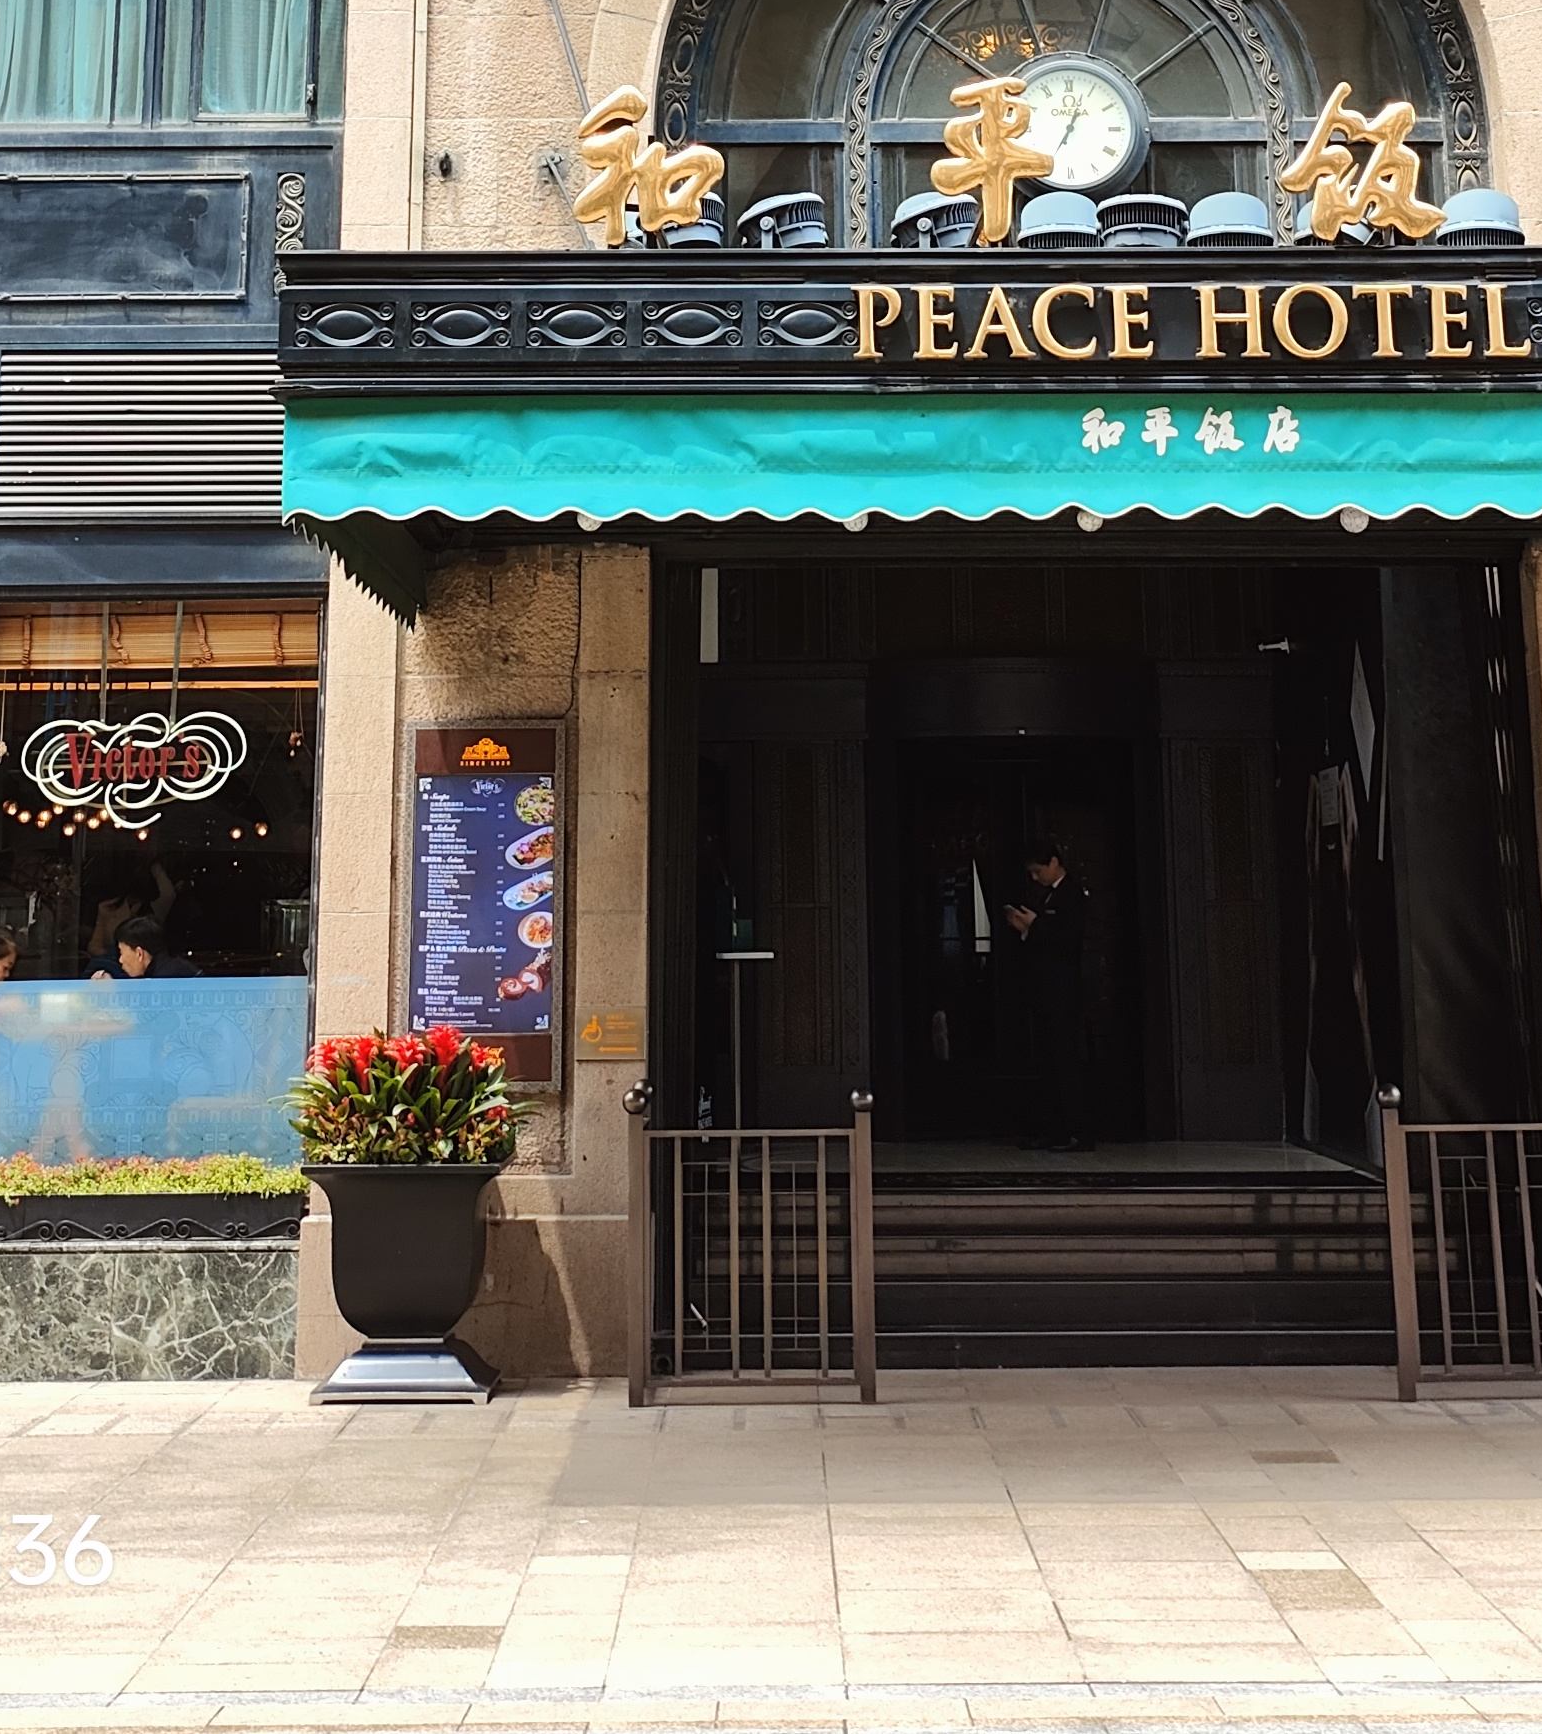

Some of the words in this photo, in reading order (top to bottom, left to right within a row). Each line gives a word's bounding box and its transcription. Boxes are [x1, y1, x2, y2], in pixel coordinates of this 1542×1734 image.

[1051, 109, 1089, 117] OMEGA
[851, 284, 1154, 359] PEACE
[1194, 283, 1532, 359] HOTEL
[64, 732, 201, 791] Victor's
